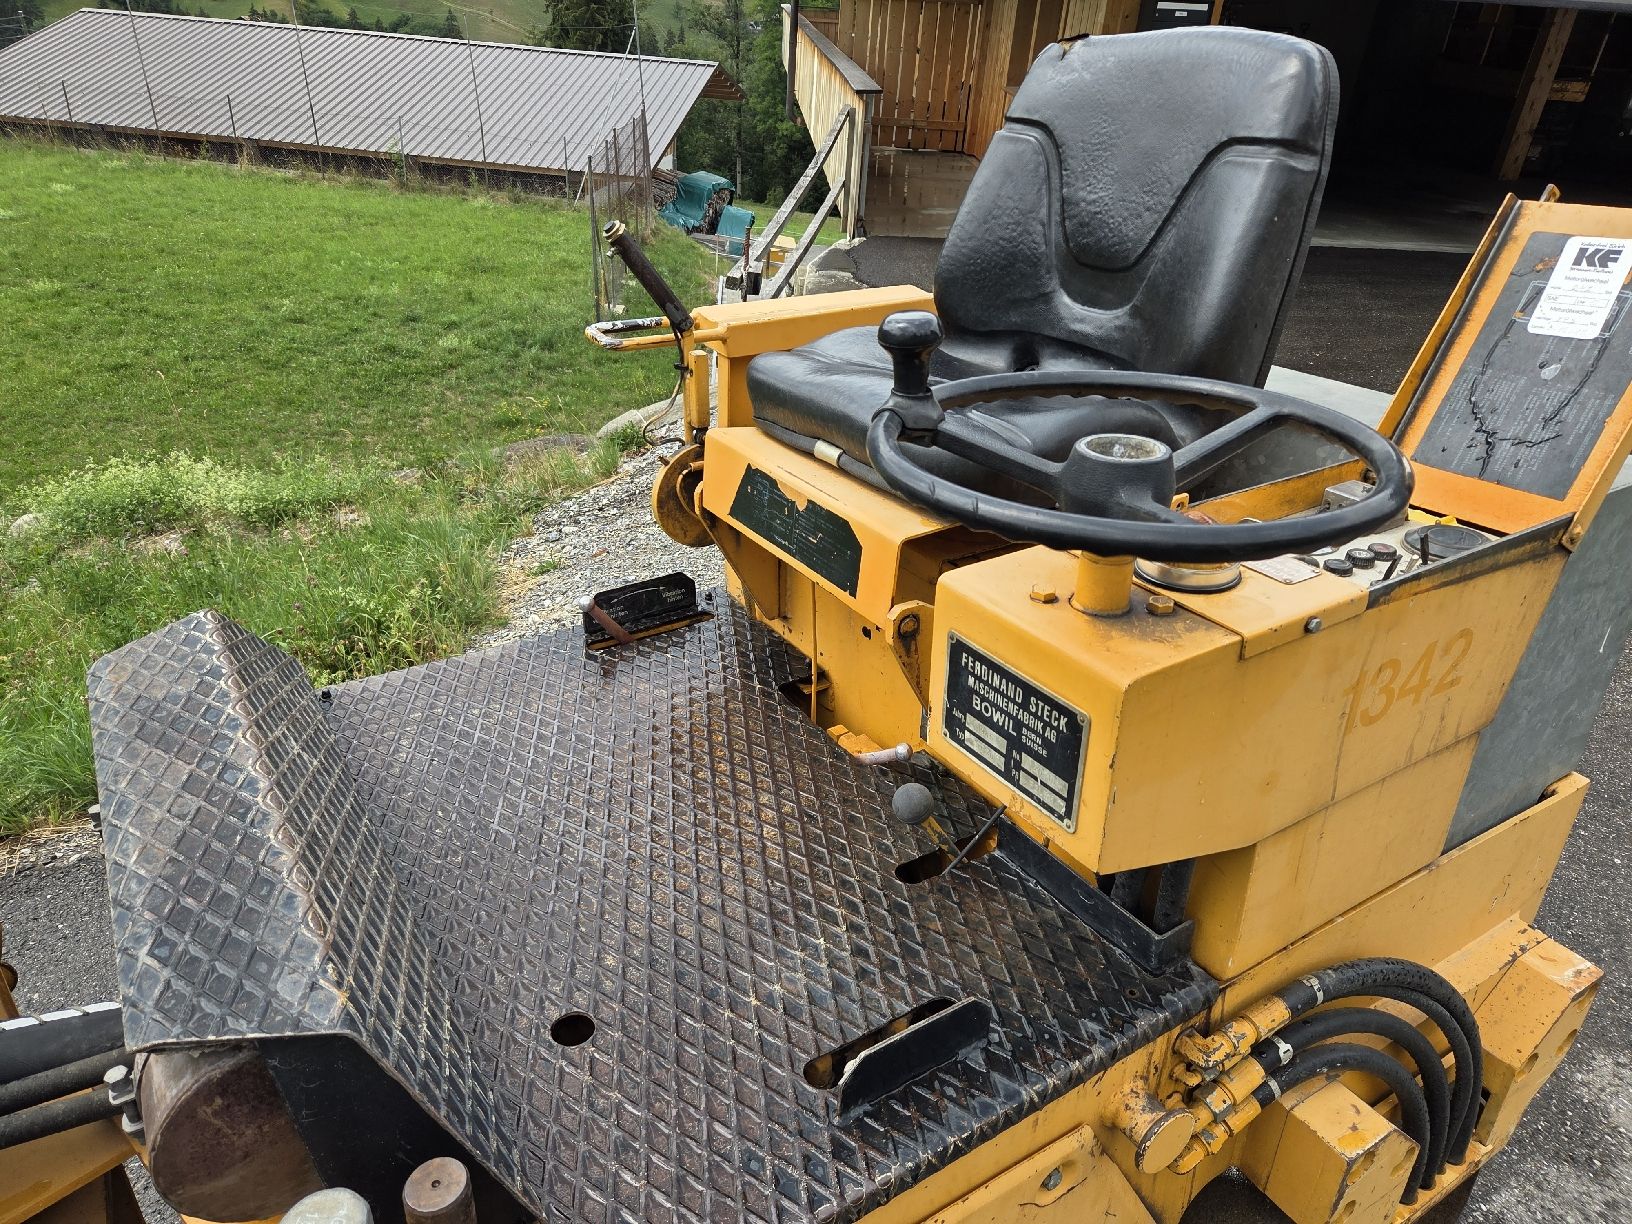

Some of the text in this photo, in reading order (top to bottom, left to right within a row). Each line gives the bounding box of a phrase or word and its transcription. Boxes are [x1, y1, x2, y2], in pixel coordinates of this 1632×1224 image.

[1571, 247, 1624, 269] KF
[961, 652, 1068, 733] FERDINAND STECK
[1342, 627, 1474, 738] 1342
[967, 674, 1057, 744] MASCHINENFABRIK AG
[972, 694, 1017, 737] BOWIL
[955, 727, 965, 741] Typ
[1021, 726, 1042, 745] BERN
[1021, 735, 1048, 758] SUISSE
